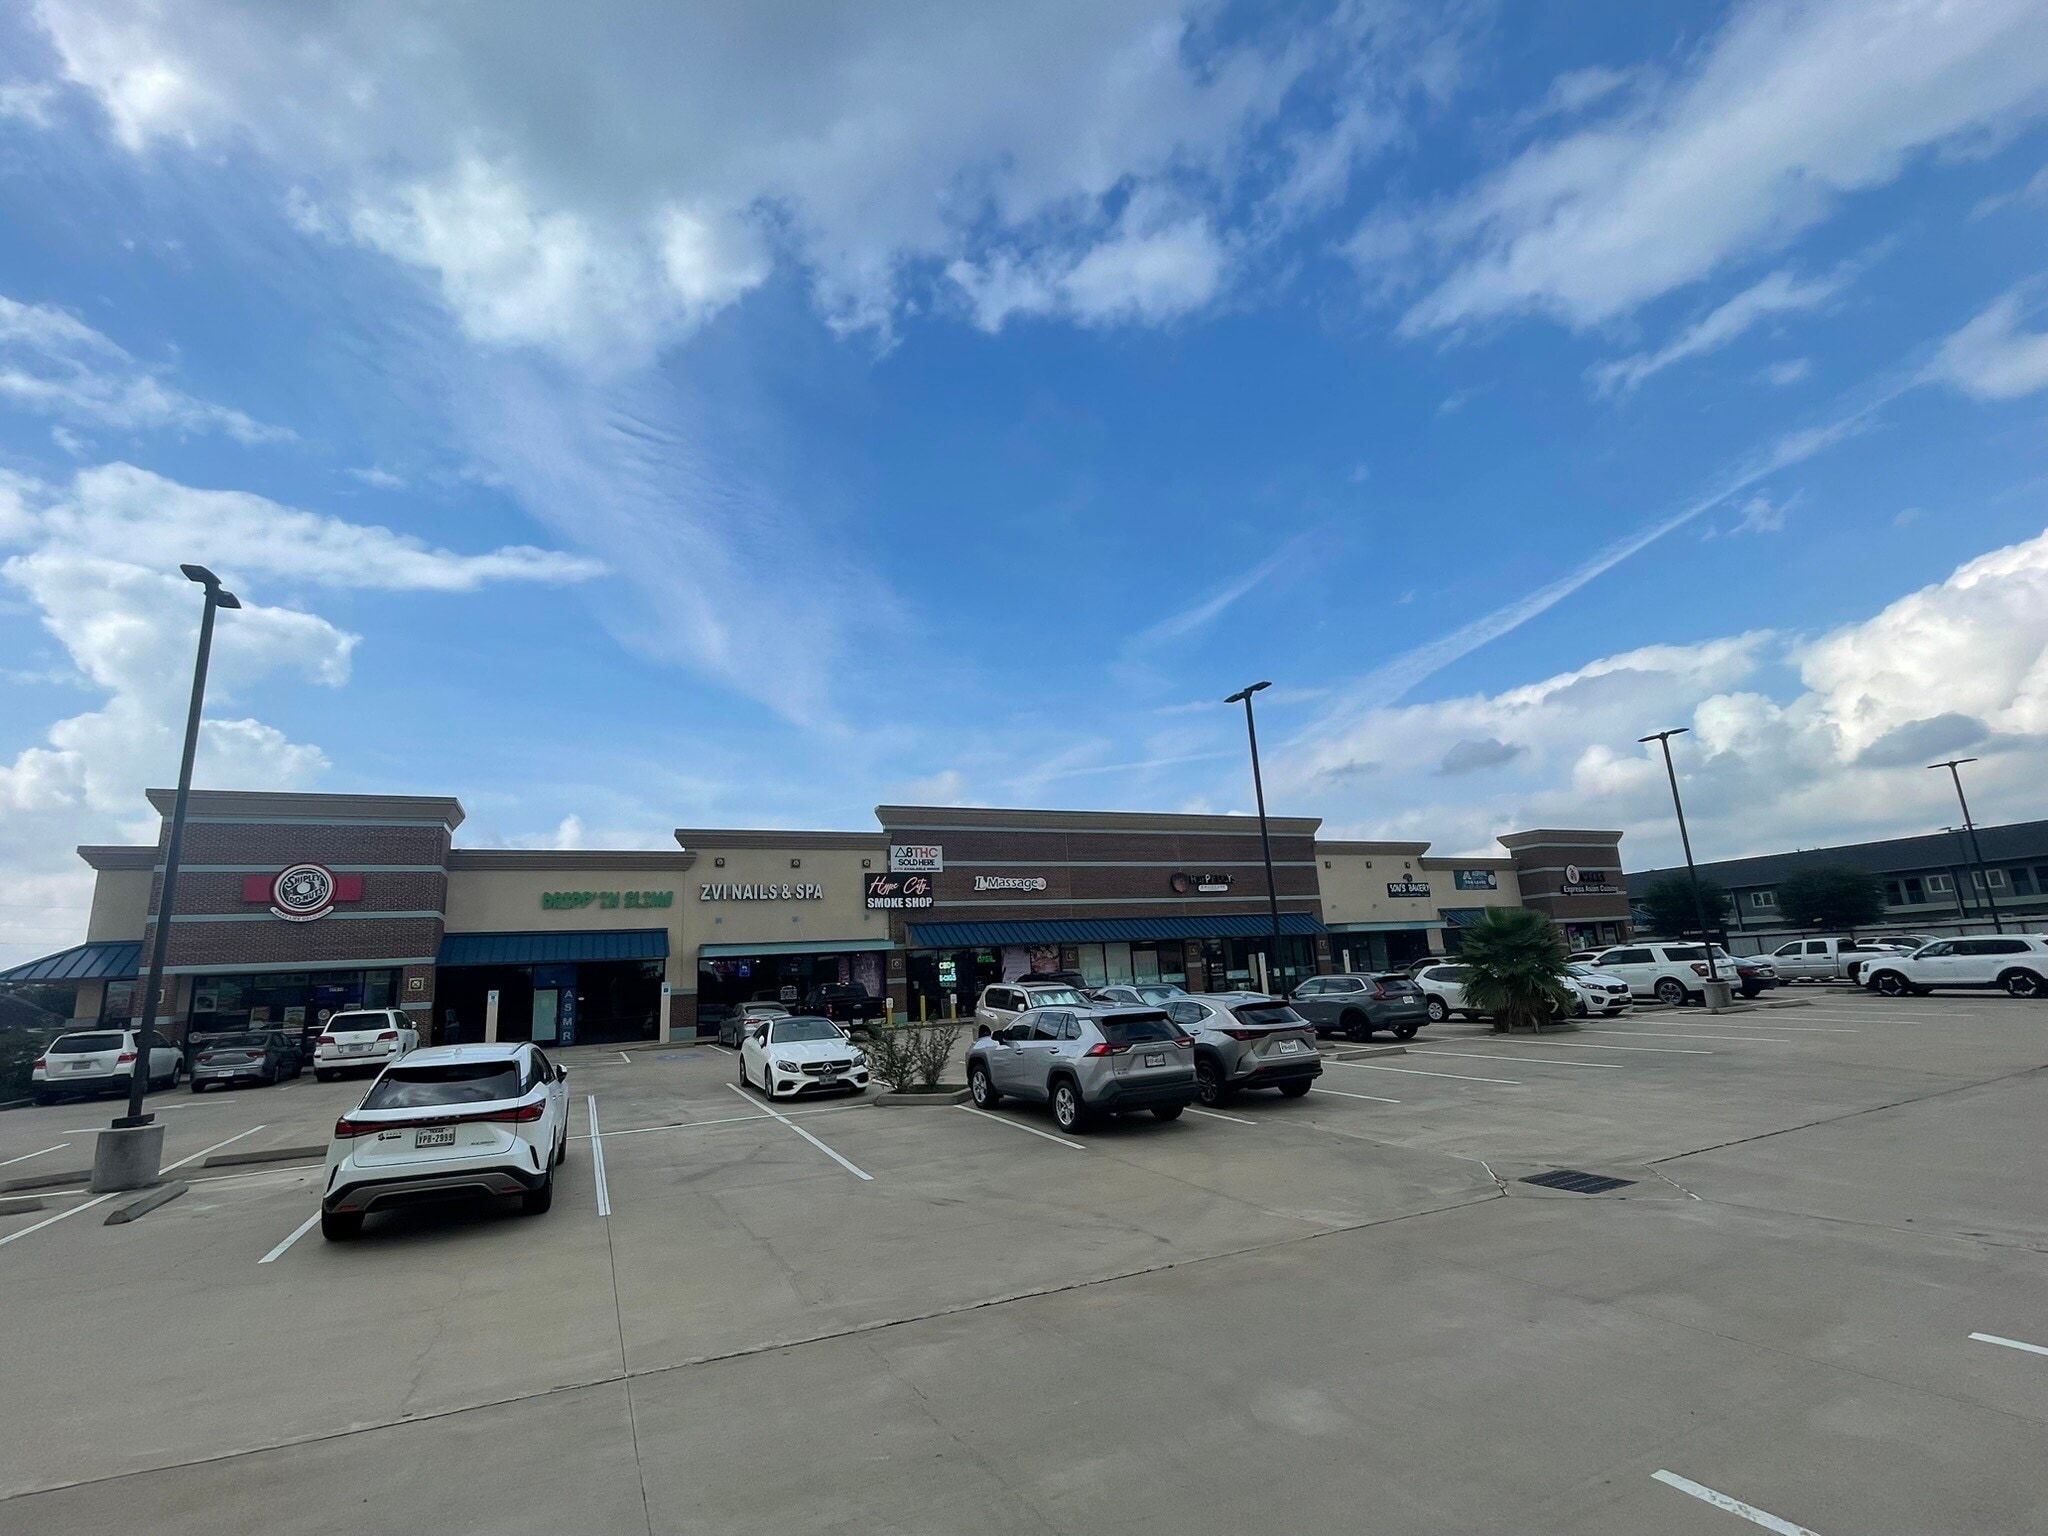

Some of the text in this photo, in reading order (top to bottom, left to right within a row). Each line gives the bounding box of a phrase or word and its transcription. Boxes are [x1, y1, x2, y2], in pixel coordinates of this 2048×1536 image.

[284, 874, 322, 888] SHIPLEY
[868, 876, 930, 895] Hype City
[987, 876, 1038, 891] Massage
[289, 888, 324, 904] DO-NUTS
[701, 884, 823, 900] ZVI NAILS & SPA
[1563, 885, 1584, 893] Express
[867, 897, 933, 908] SMOKE SHOP
[562, 990, 573, 1040] ASMR
